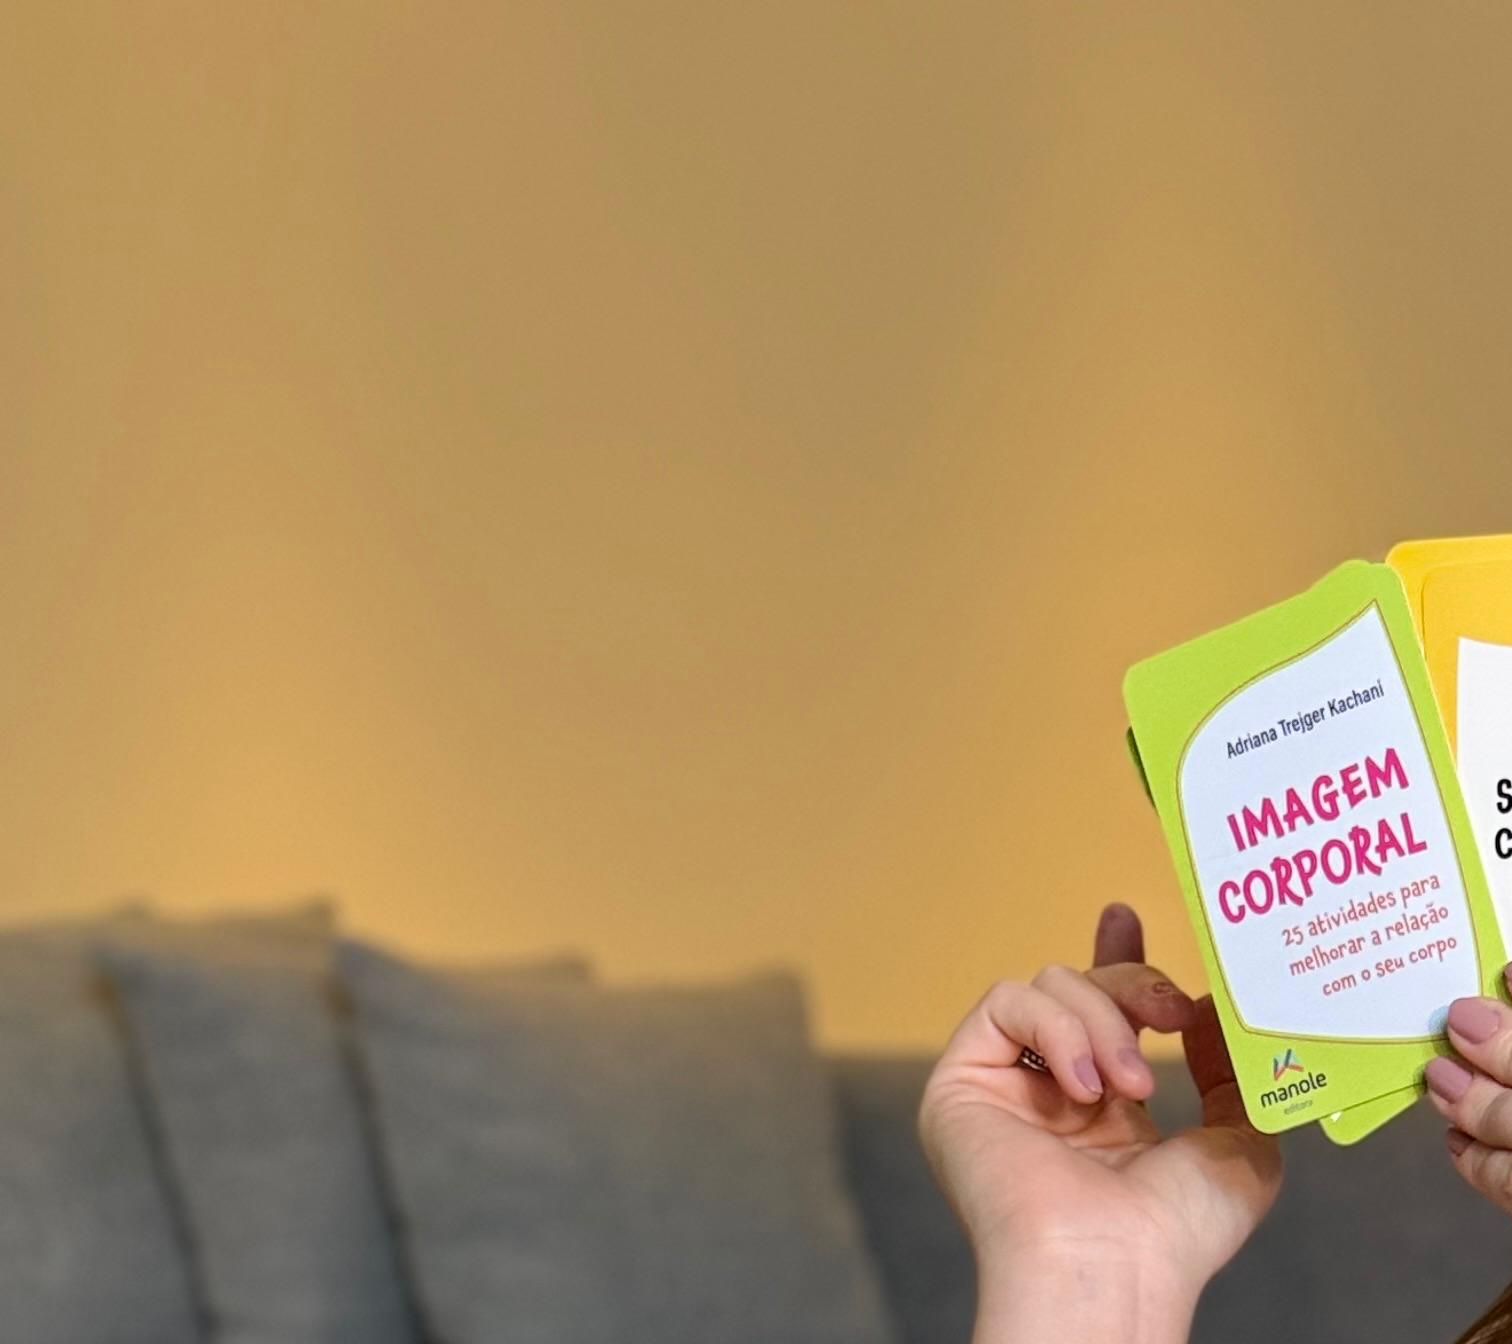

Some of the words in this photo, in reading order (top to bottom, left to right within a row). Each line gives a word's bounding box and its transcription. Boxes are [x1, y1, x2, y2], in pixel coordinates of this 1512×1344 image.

[1227, 728, 1278, 759] Adriana
[1278, 708, 1326, 736] Trejger
[1327, 679, 1385, 717] Kachani
[1227, 747, 1409, 852] IMAGEM
[1218, 812, 1428, 924] CORPORAL
[1282, 927, 1304, 947] 25
[1308, 891, 1396, 937] atividades
[1400, 874, 1441, 909] para
[1289, 936, 1366, 977] melhorar
[1371, 930, 1382, 946] a
[1385, 902, 1449, 942] relação
[1322, 973, 1357, 996] com
[1361, 966, 1372, 982] o
[1375, 953, 1405, 978] seu
[1408, 936, 1458, 963] corpo
[1260, 1071, 1328, 1109] manole
